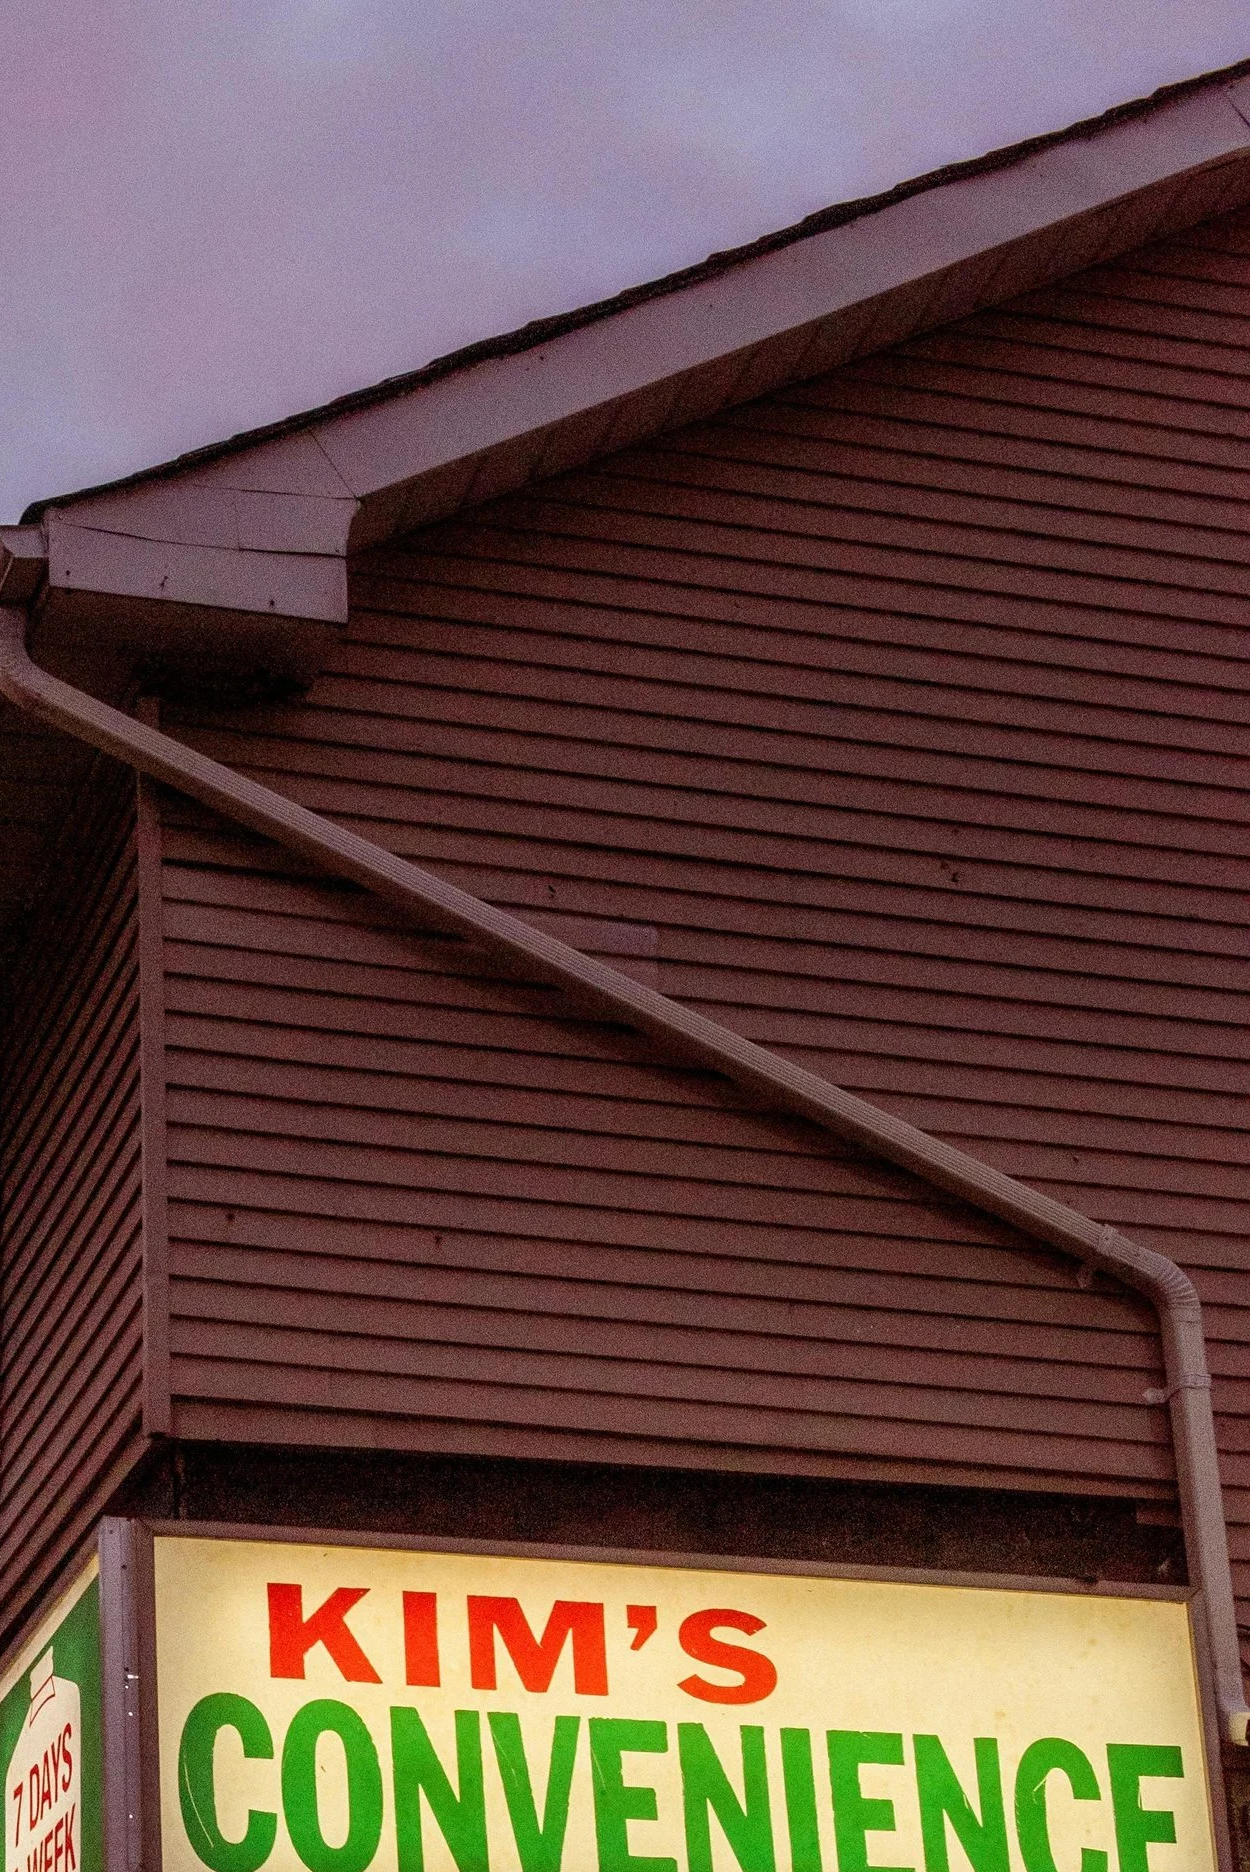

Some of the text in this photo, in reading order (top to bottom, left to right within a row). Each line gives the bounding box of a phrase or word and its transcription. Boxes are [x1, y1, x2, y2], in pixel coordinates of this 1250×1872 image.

[266, 1582, 779, 1706] KIM'S
[12, 1722, 73, 1849] 7 DAYS
